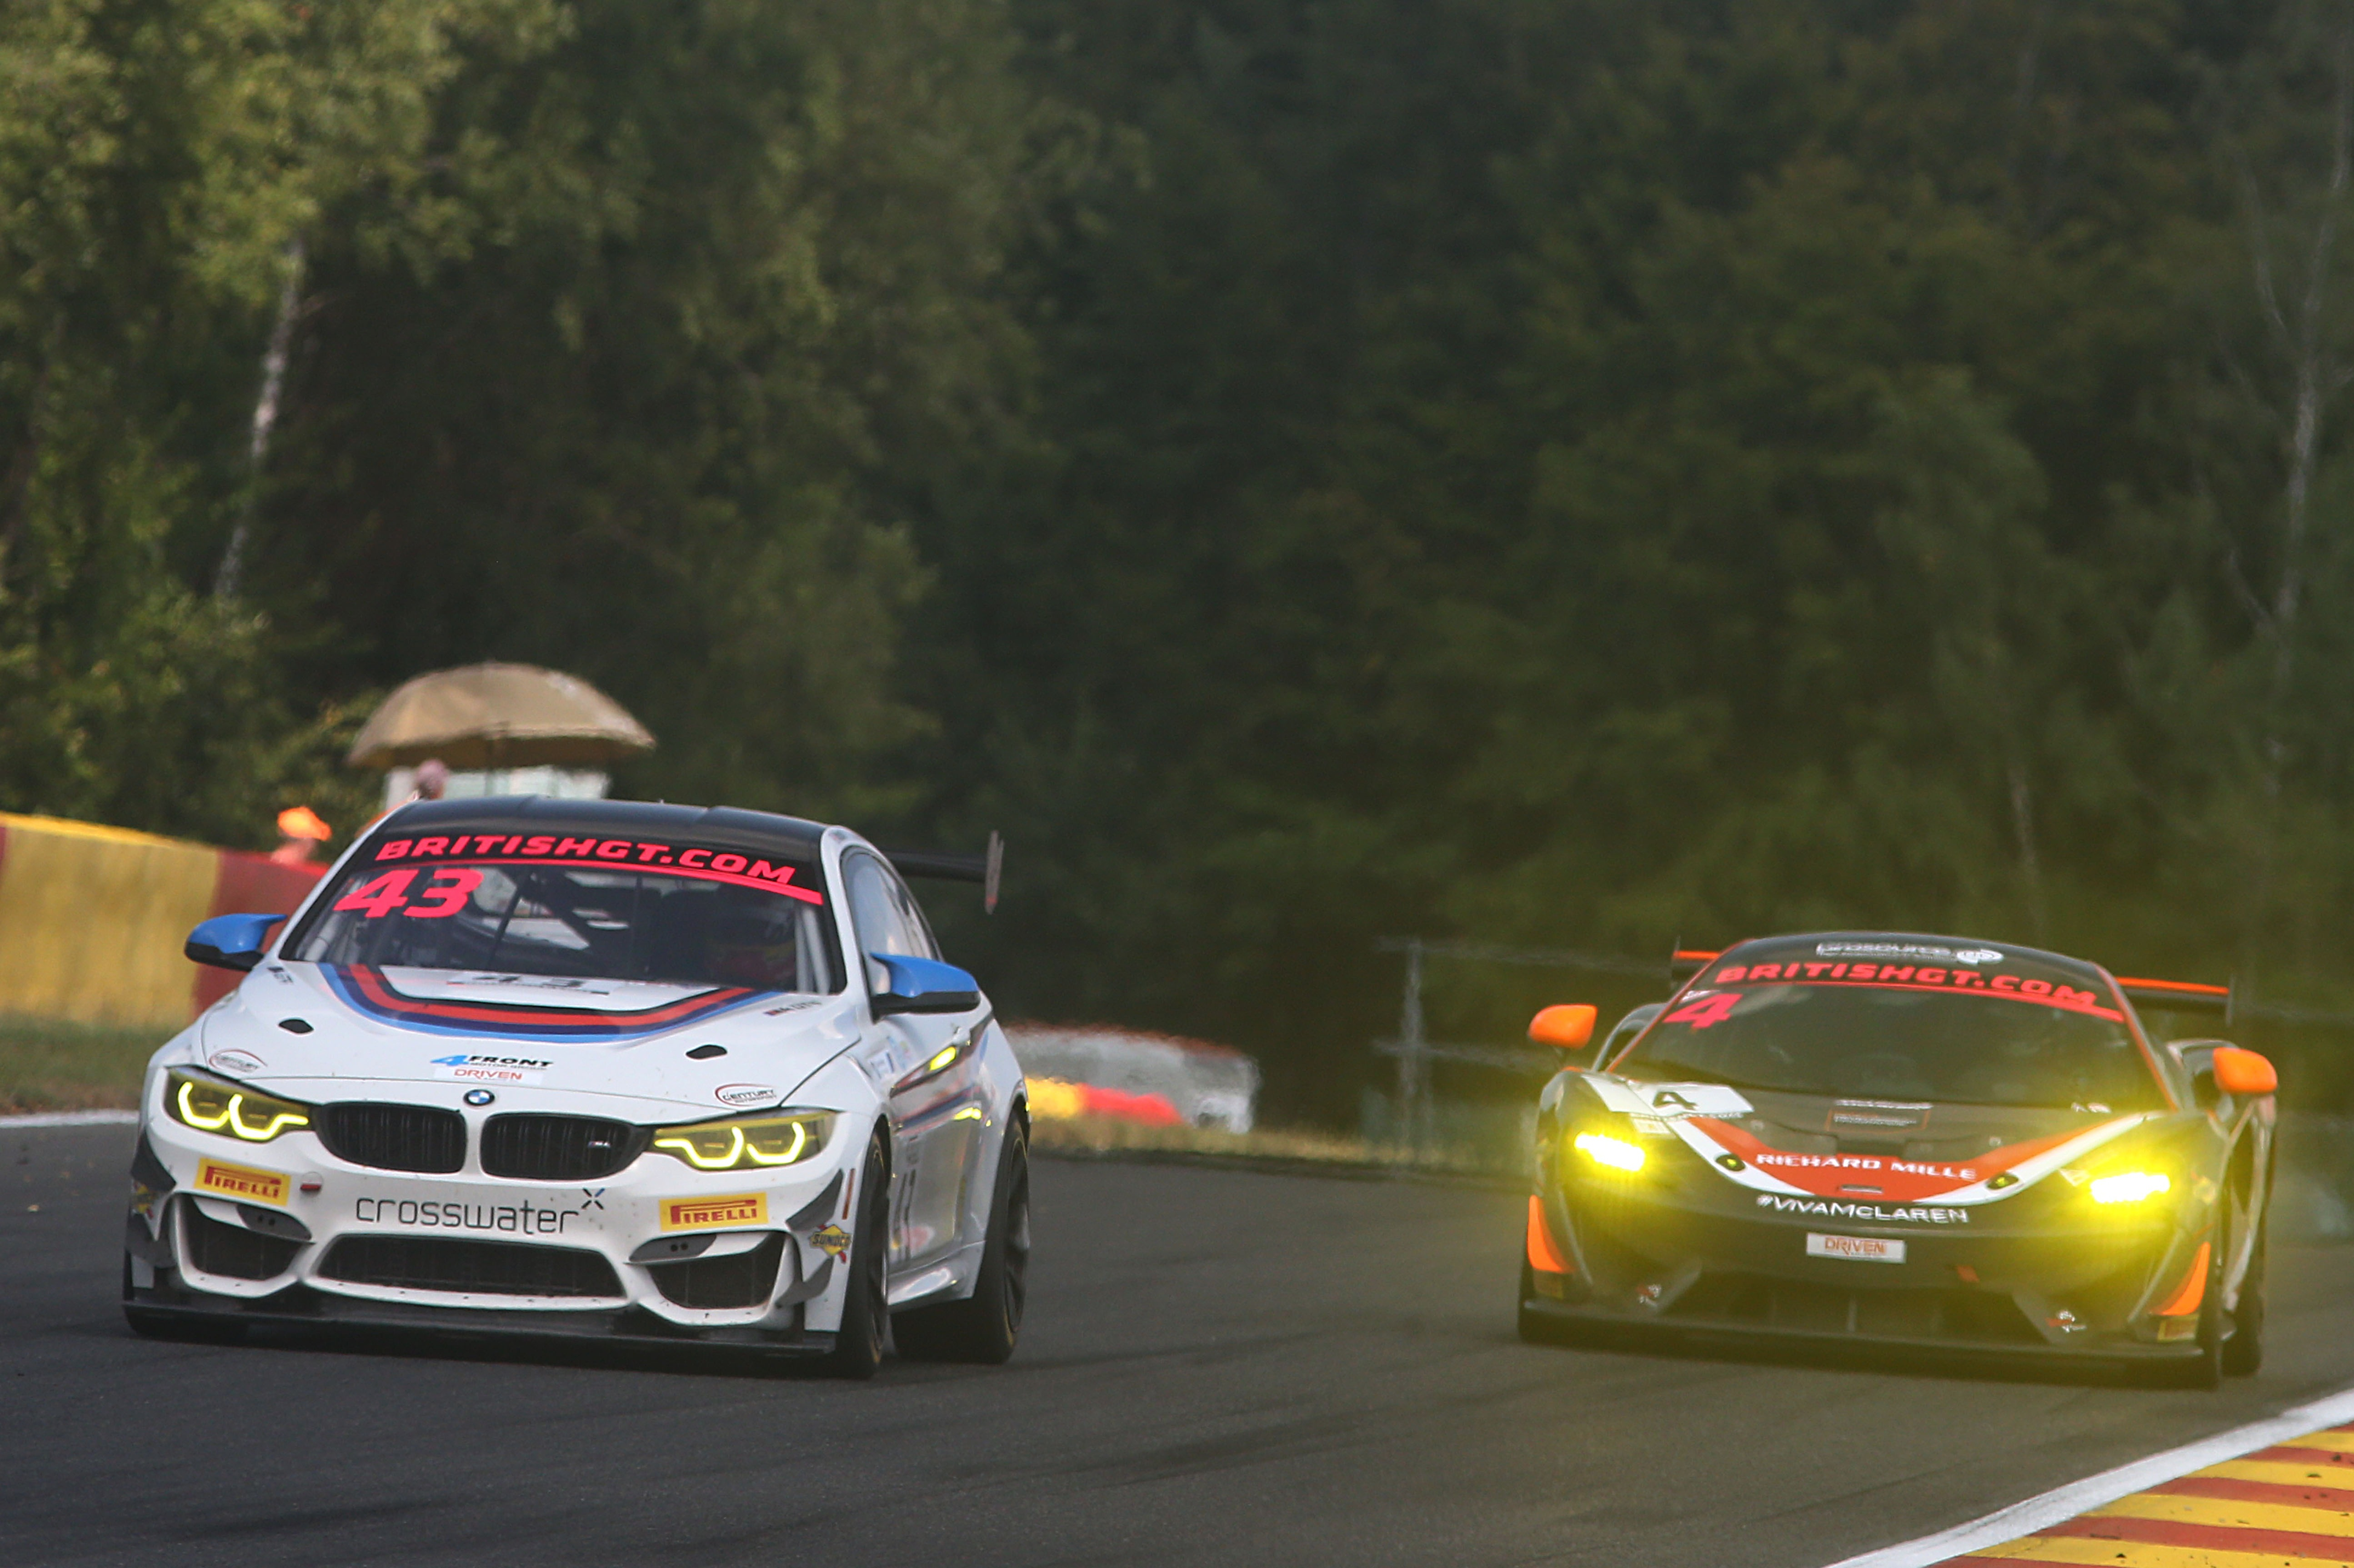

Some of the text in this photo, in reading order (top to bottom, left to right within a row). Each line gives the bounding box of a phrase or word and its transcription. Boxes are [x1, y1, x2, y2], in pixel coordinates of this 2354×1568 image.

[375, 835, 796, 884] BRITISHGT.COM
[333, 868, 484, 918] 43
[1715, 962, 2097, 1005] BRITISHGT.COM
[1662, 993, 1743, 1029] 4
[454, 1069, 523, 1080] DRIVEN
[204, 1166, 282, 1199] PIRELLI
[1755, 1154, 1977, 1180] RICHARD MILLE
[356, 1198, 580, 1235] crosswater
[670, 1199, 757, 1225] PIRELLI
[1756, 1194, 1969, 1223] #VIVAMCLAREN
[1824, 1236, 1887, 1256] DRIVEN
